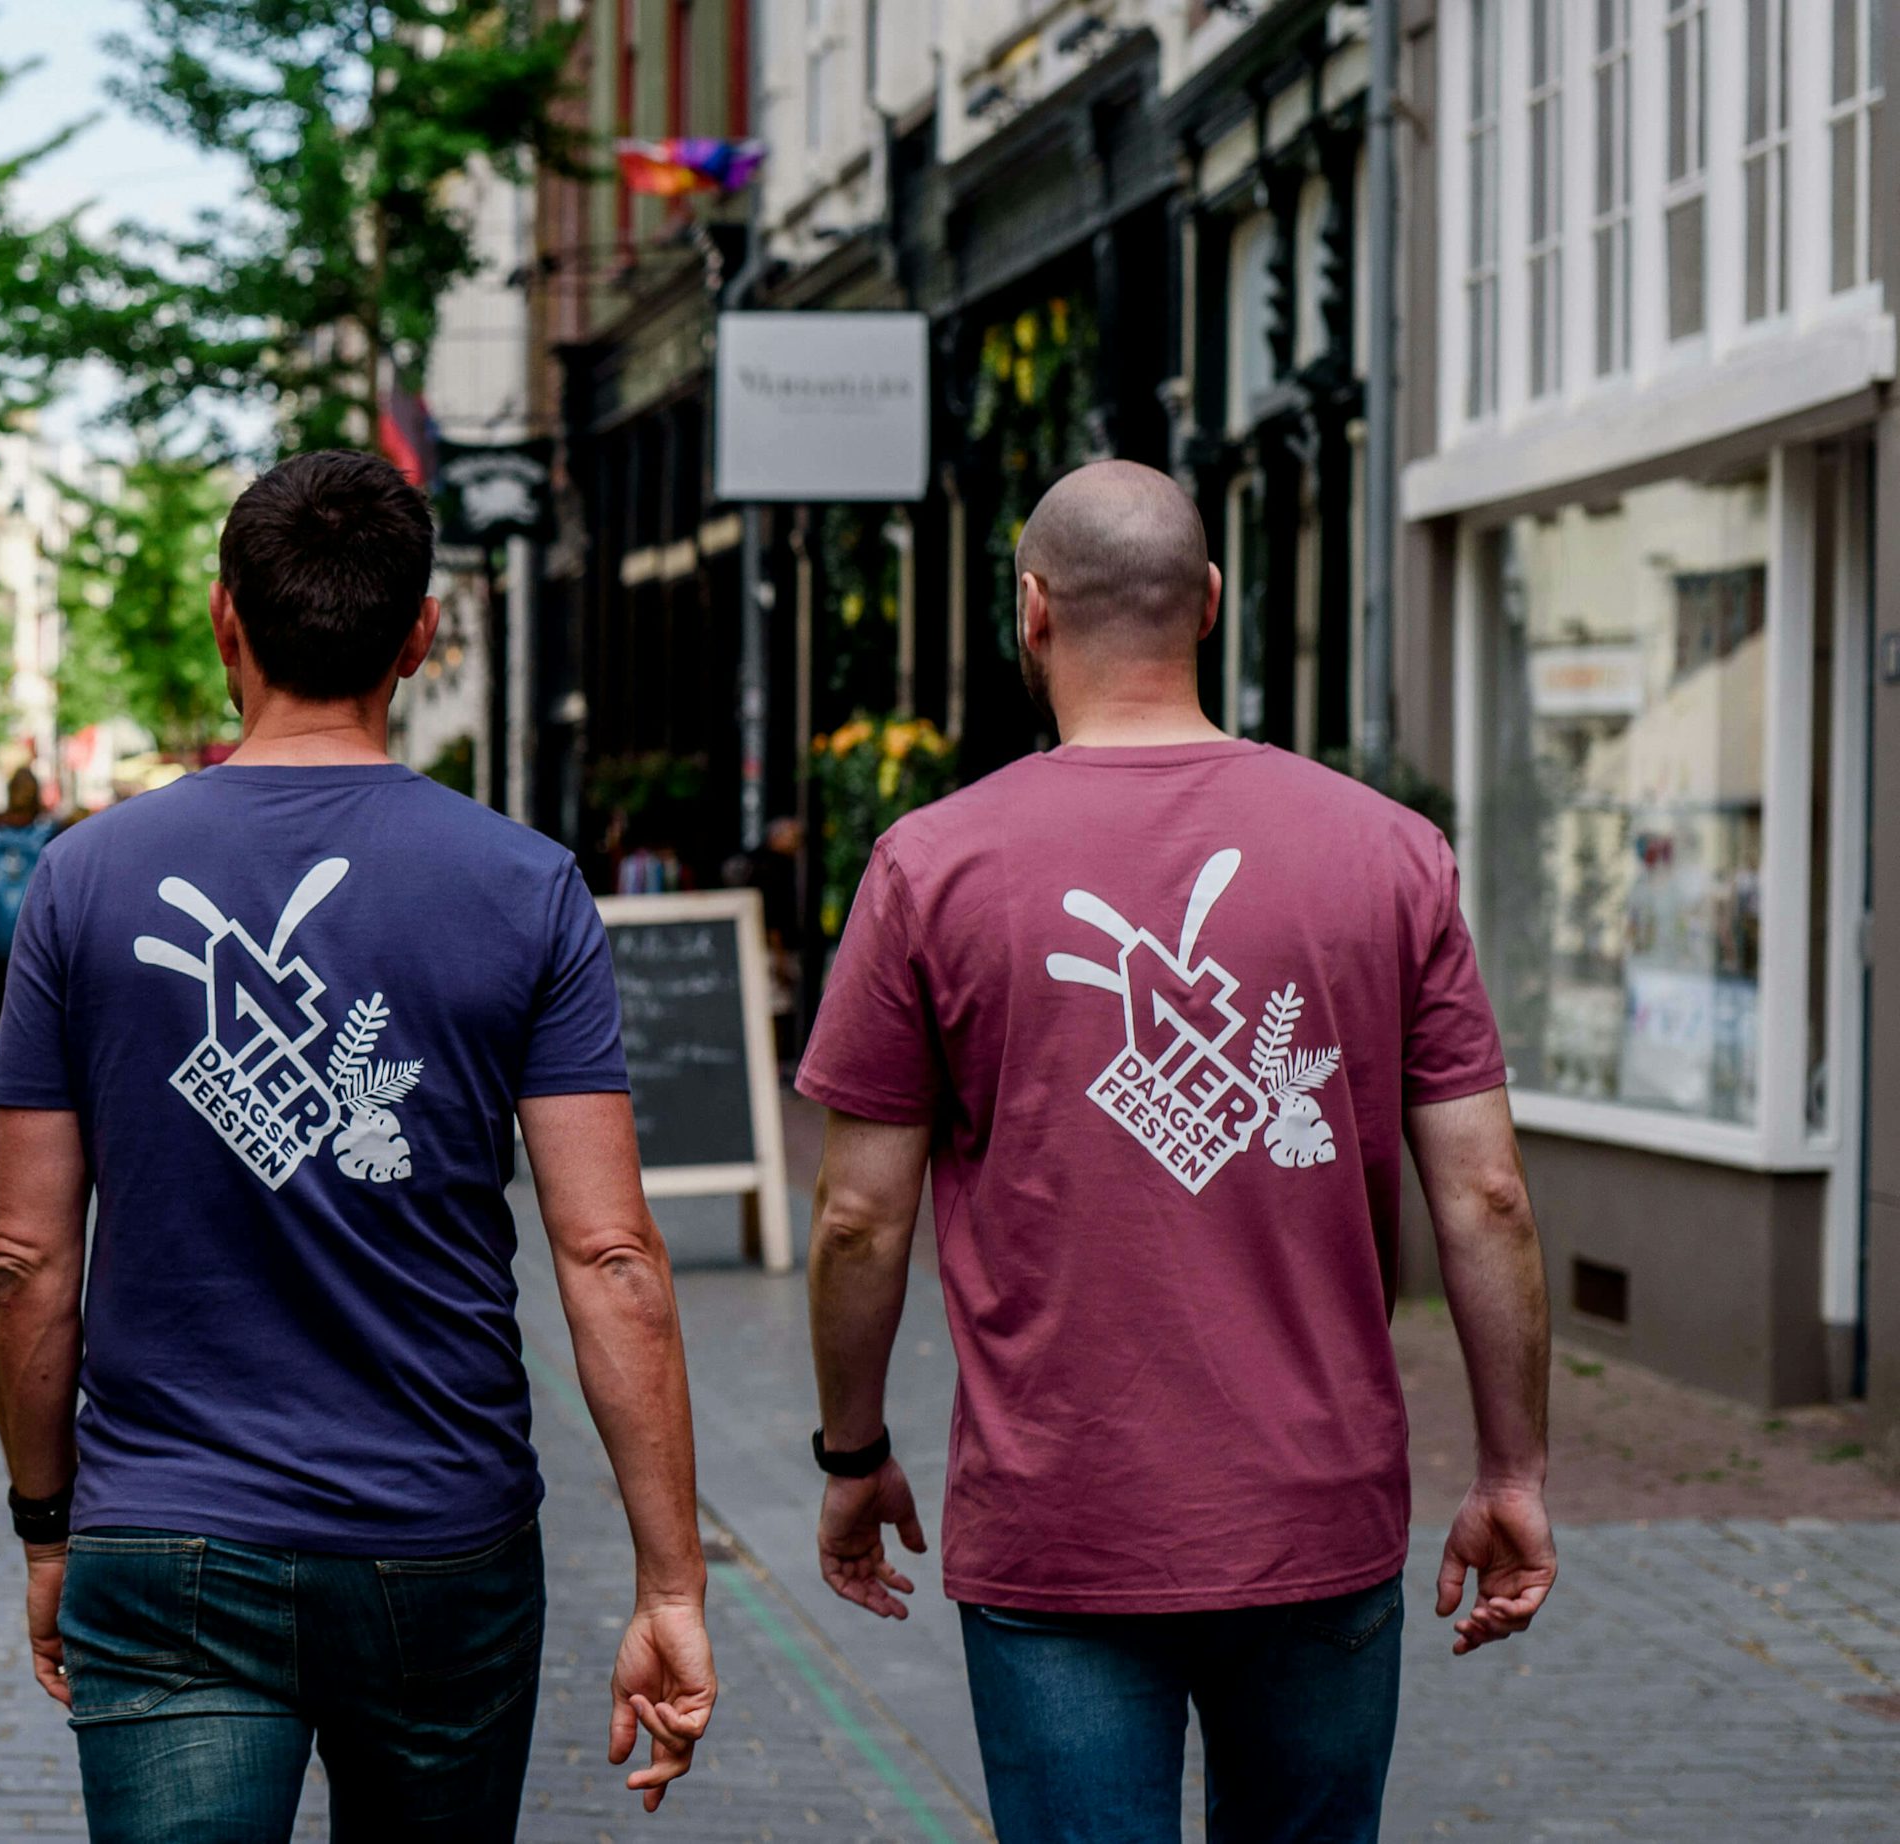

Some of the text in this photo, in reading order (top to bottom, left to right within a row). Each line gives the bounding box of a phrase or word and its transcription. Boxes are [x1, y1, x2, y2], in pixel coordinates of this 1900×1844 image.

[180, 1065, 285, 1180] FEESTEN
[195, 1044, 299, 1160] DAAGSE
[1097, 1077, 1207, 1183] FEESTEN
[1115, 1054, 1228, 1162] DAAGSE
